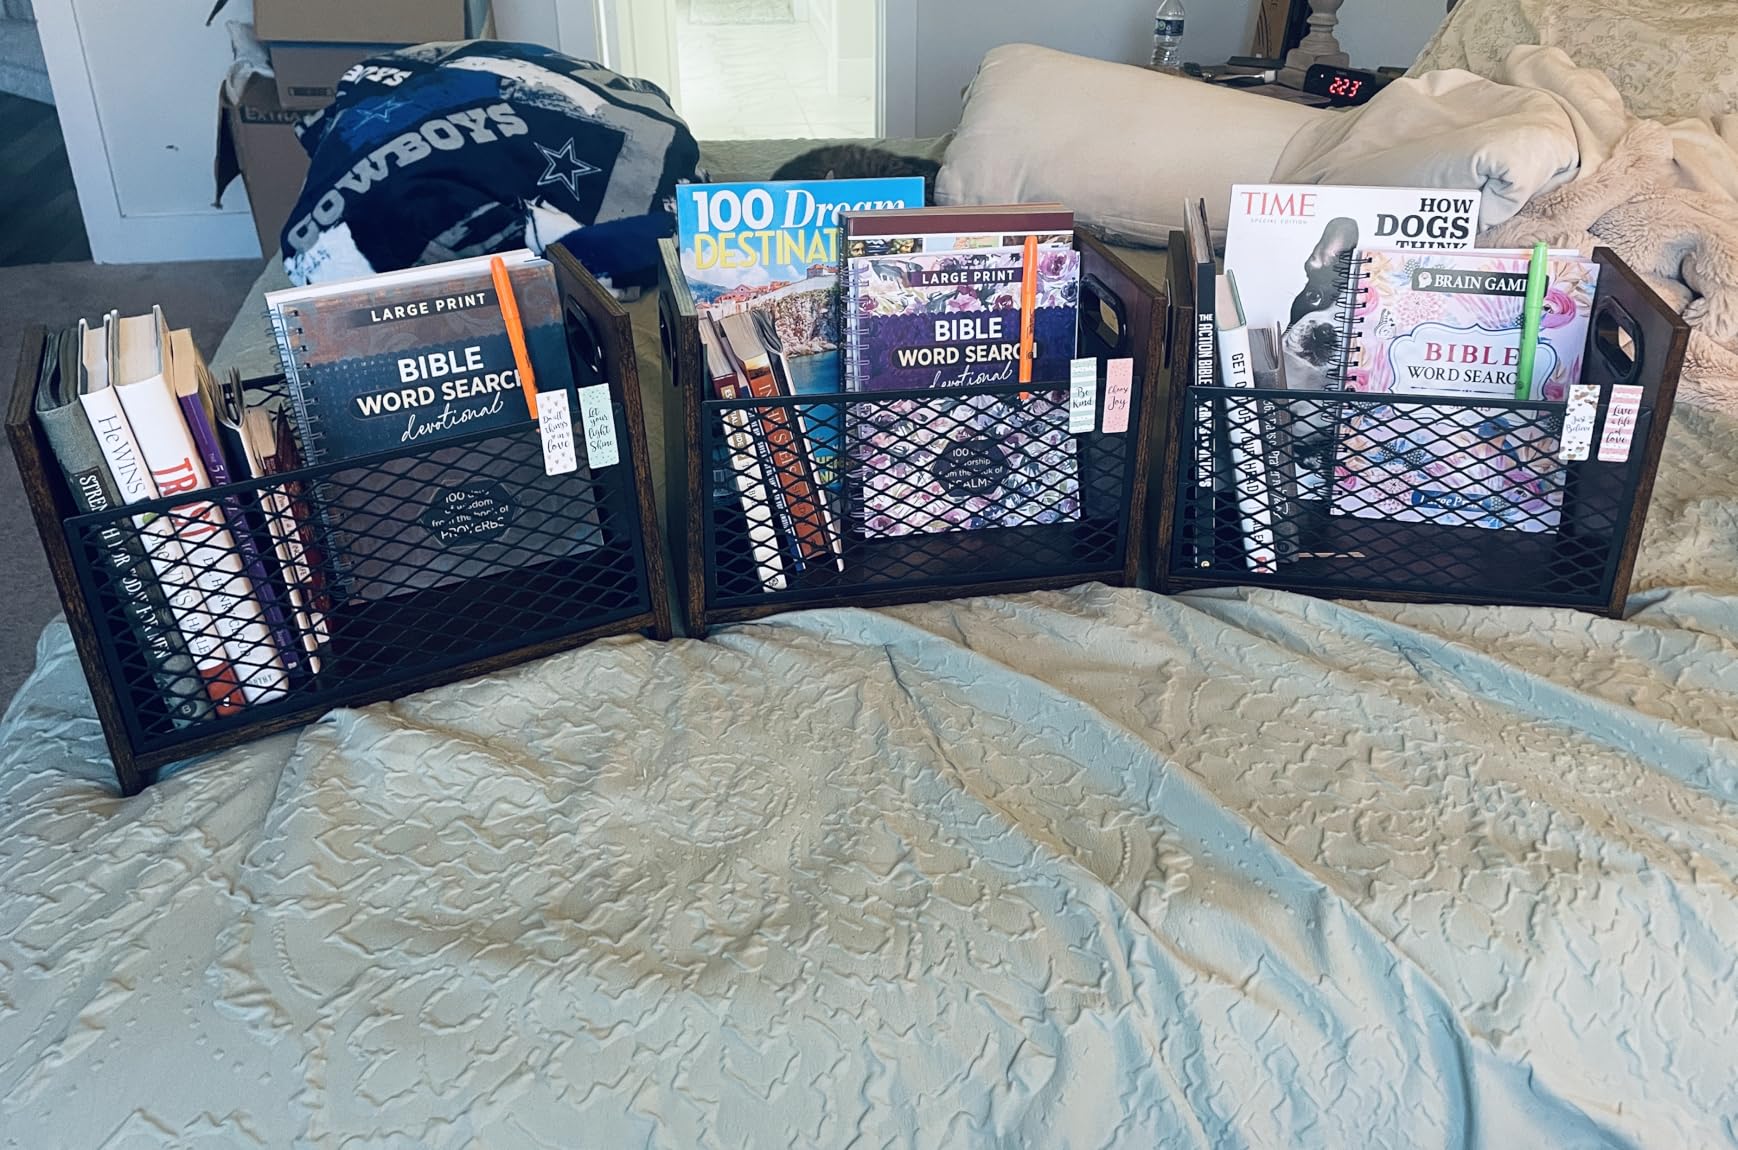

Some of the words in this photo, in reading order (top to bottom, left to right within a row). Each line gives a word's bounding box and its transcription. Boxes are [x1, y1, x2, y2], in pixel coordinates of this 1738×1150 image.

[288, 103, 528, 251] COWBOYS
[692, 188, 774, 233] 100
[1241, 191, 1318, 217] TIME
[1418, 197, 1474, 214] HOW
[1374, 214, 1470, 240] DOGS
[693, 228, 839, 270] DESTINAT
[922, 272, 968, 284] LARGE
[973, 269, 1014, 282] PRINT
[1434, 274, 1481, 290] BRAIN
[1485, 278, 1528, 292] GAM
[371, 302, 429, 322] LARGE
[436, 292, 486, 313] PRINT
[1199, 313, 1213, 321] THE
[935, 317, 1002, 342] BIBLE
[1198, 323, 1214, 358] ACTION
[398, 346, 484, 383] BIBLE
[898, 347, 960, 367] WORD
[1231, 353, 1246, 375] GET
[1424, 342, 1520, 366] BIBLE
[1198, 359, 1213, 385] BIBLE
[1407, 365, 1460, 382] WORD
[1463, 369, 1518, 386] SEARC
[356, 385, 436, 417] WORD
[401, 391, 504, 443] devotional
[952, 447, 969, 457] 100
[964, 457, 991, 466] orship
[209, 462, 223, 474] 5
[152, 457, 217, 545] TRST
